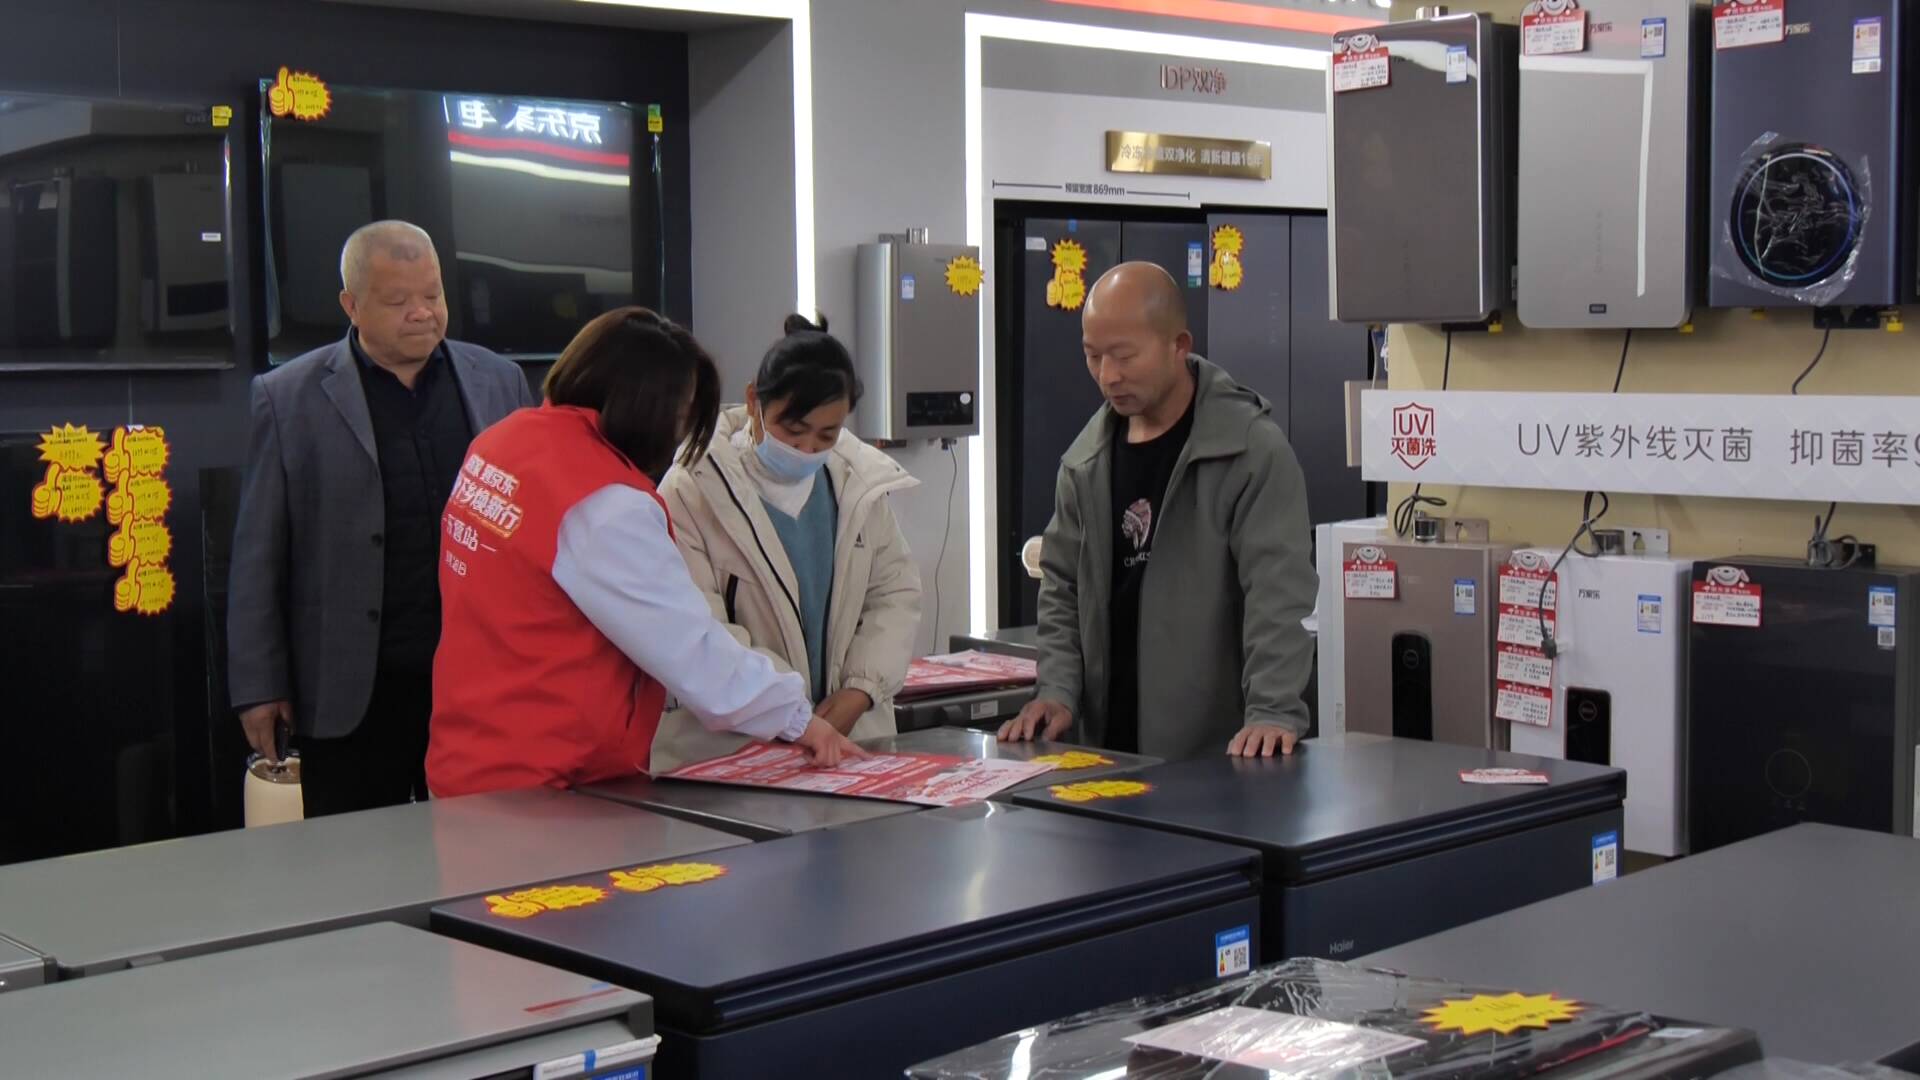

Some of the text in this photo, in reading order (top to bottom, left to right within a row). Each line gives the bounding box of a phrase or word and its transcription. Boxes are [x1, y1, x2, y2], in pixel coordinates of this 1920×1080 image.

[1120, 144, 1196, 164] 冷冻双净化
[1398, 412, 1429, 436] UV
[1391, 437, 1437, 457] 灭菌洗
[1516, 423, 1754, 463] UV紫外线灭菌
